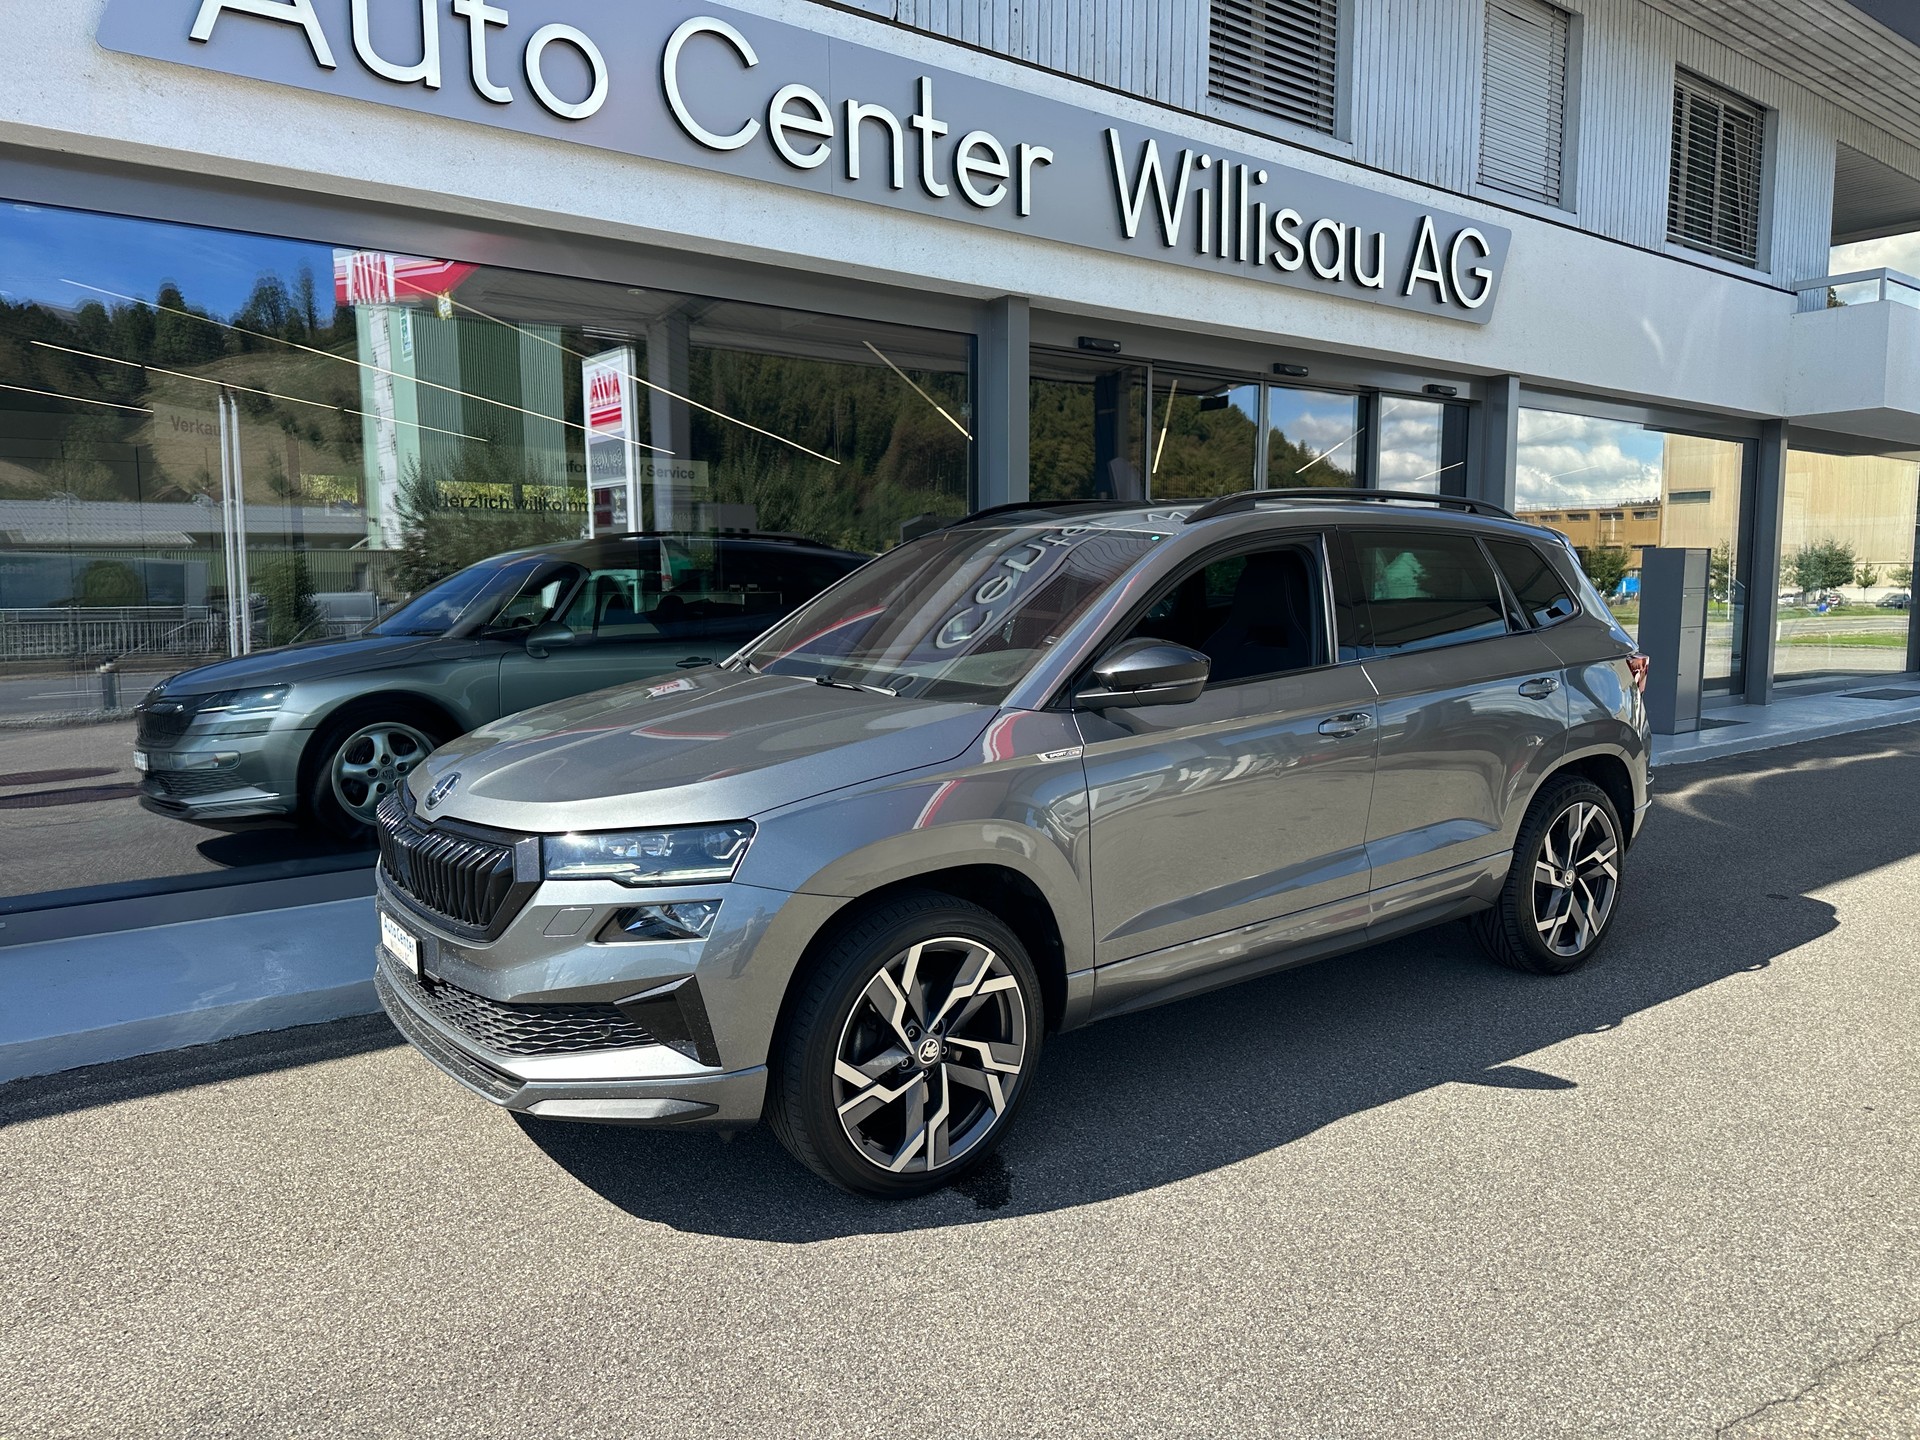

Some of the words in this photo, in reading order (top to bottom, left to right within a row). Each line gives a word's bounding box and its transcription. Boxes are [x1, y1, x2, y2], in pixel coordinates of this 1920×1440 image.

[661, 16, 1054, 217] Center
[1103, 127, 1386, 290] Willisau
[1401, 214, 1493, 309] AG
[170, 414, 222, 437] Verkau
[646, 465, 696, 480] Service
[513, 494, 590, 512] willkomm
